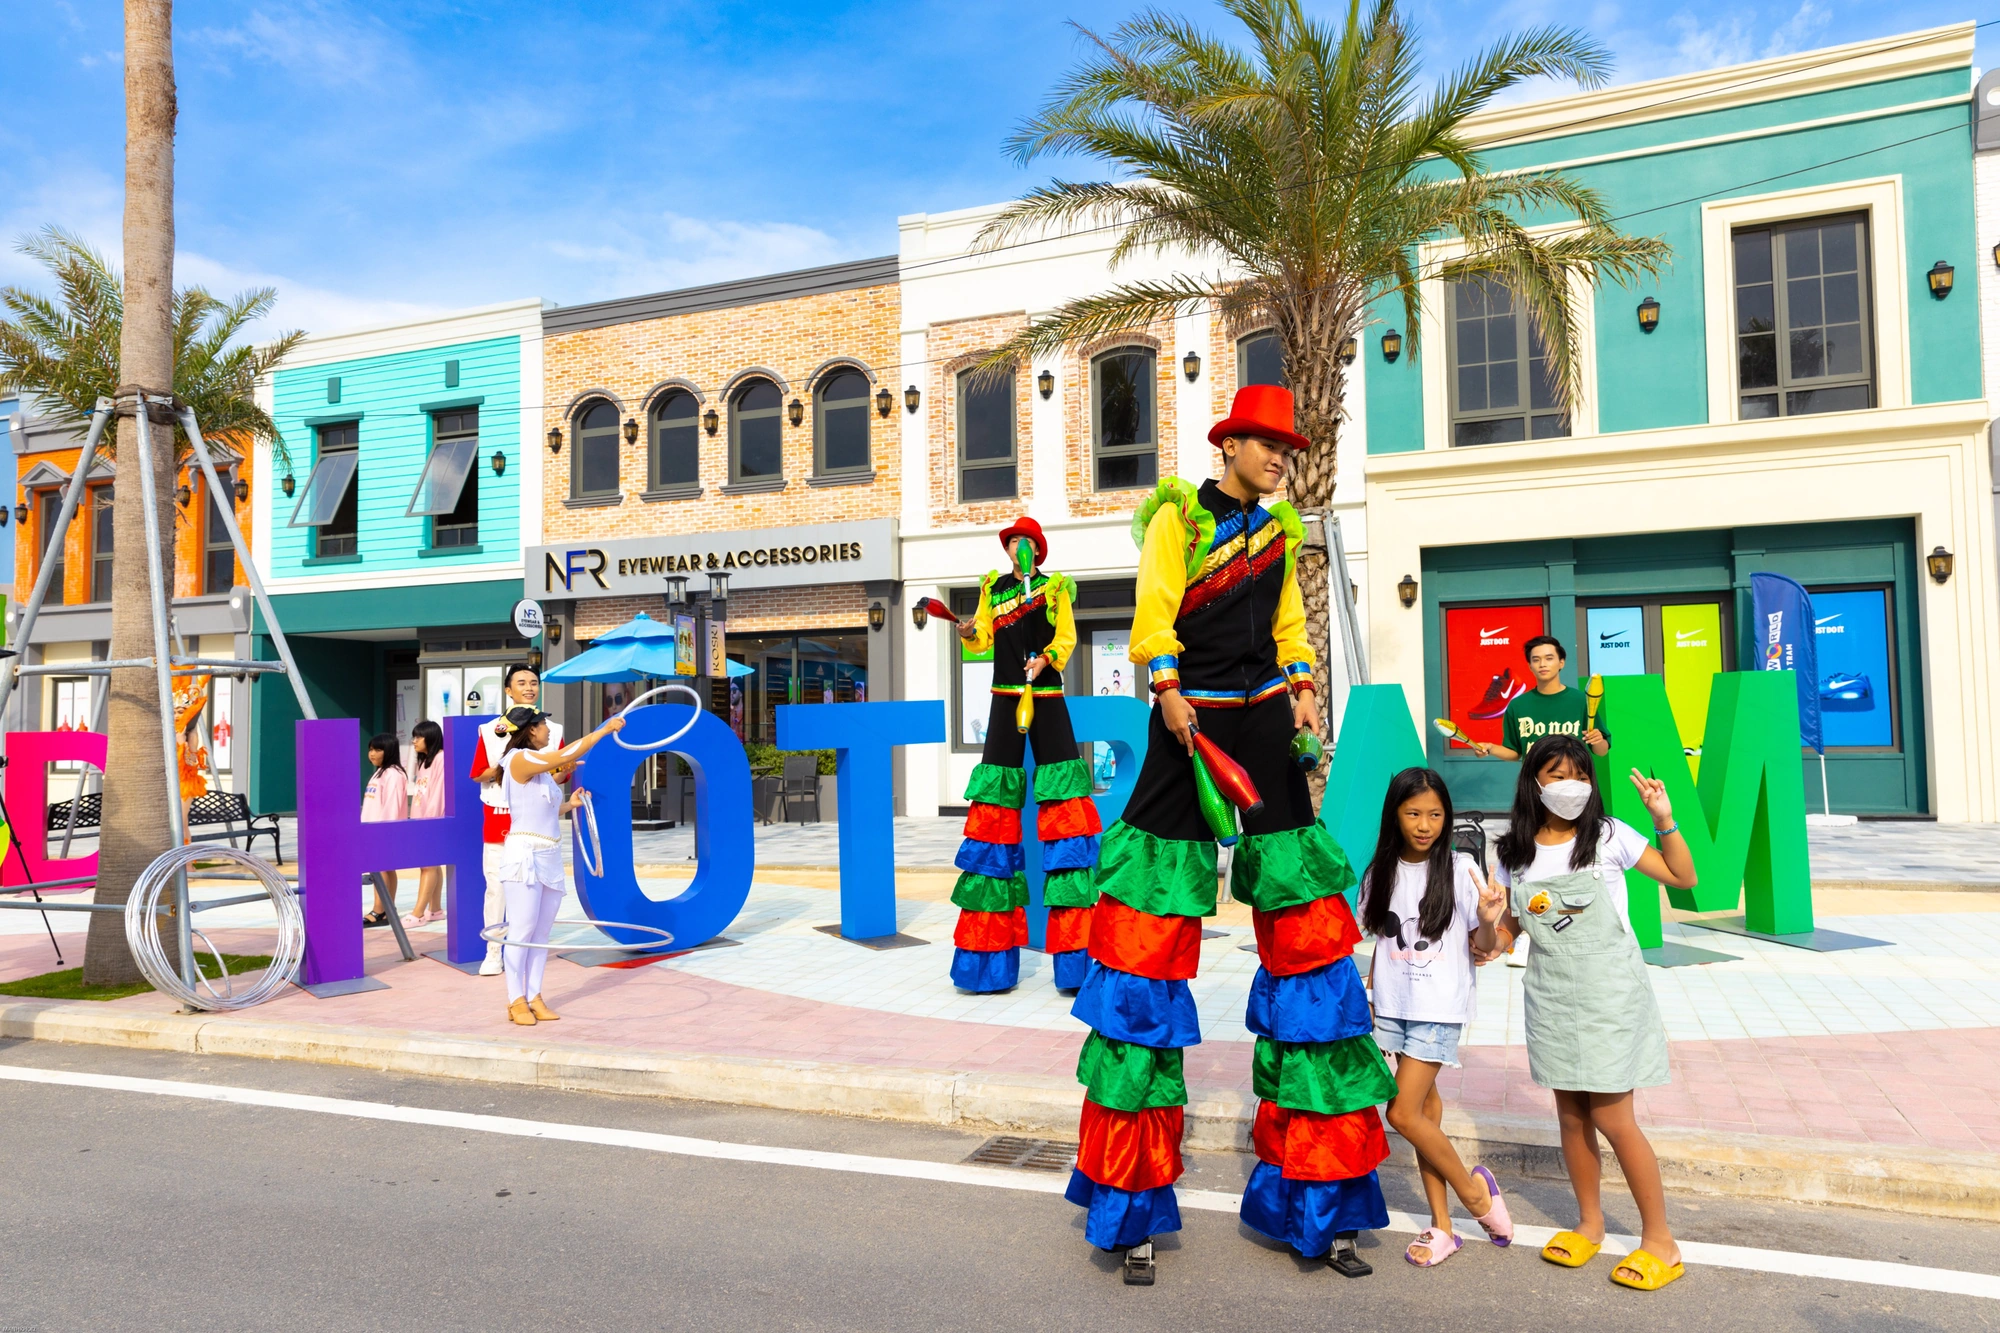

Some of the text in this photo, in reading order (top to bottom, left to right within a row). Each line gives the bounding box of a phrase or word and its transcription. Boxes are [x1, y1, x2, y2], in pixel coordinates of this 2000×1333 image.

[545, 541, 863, 593] NFR EYEWEAR & ACCESSORIES
[524, 609, 537, 619] NFR
[1826, 626, 1837, 634] DO
[1480, 637, 1493, 646] JUST
[1493, 637, 1503, 646] DO
[1676, 640, 1690, 648] JUST
[1766, 611, 1783, 671] WORLD
[1786, 643, 1794, 666] TRAM
[1518, 716, 1581, 738] Do not
